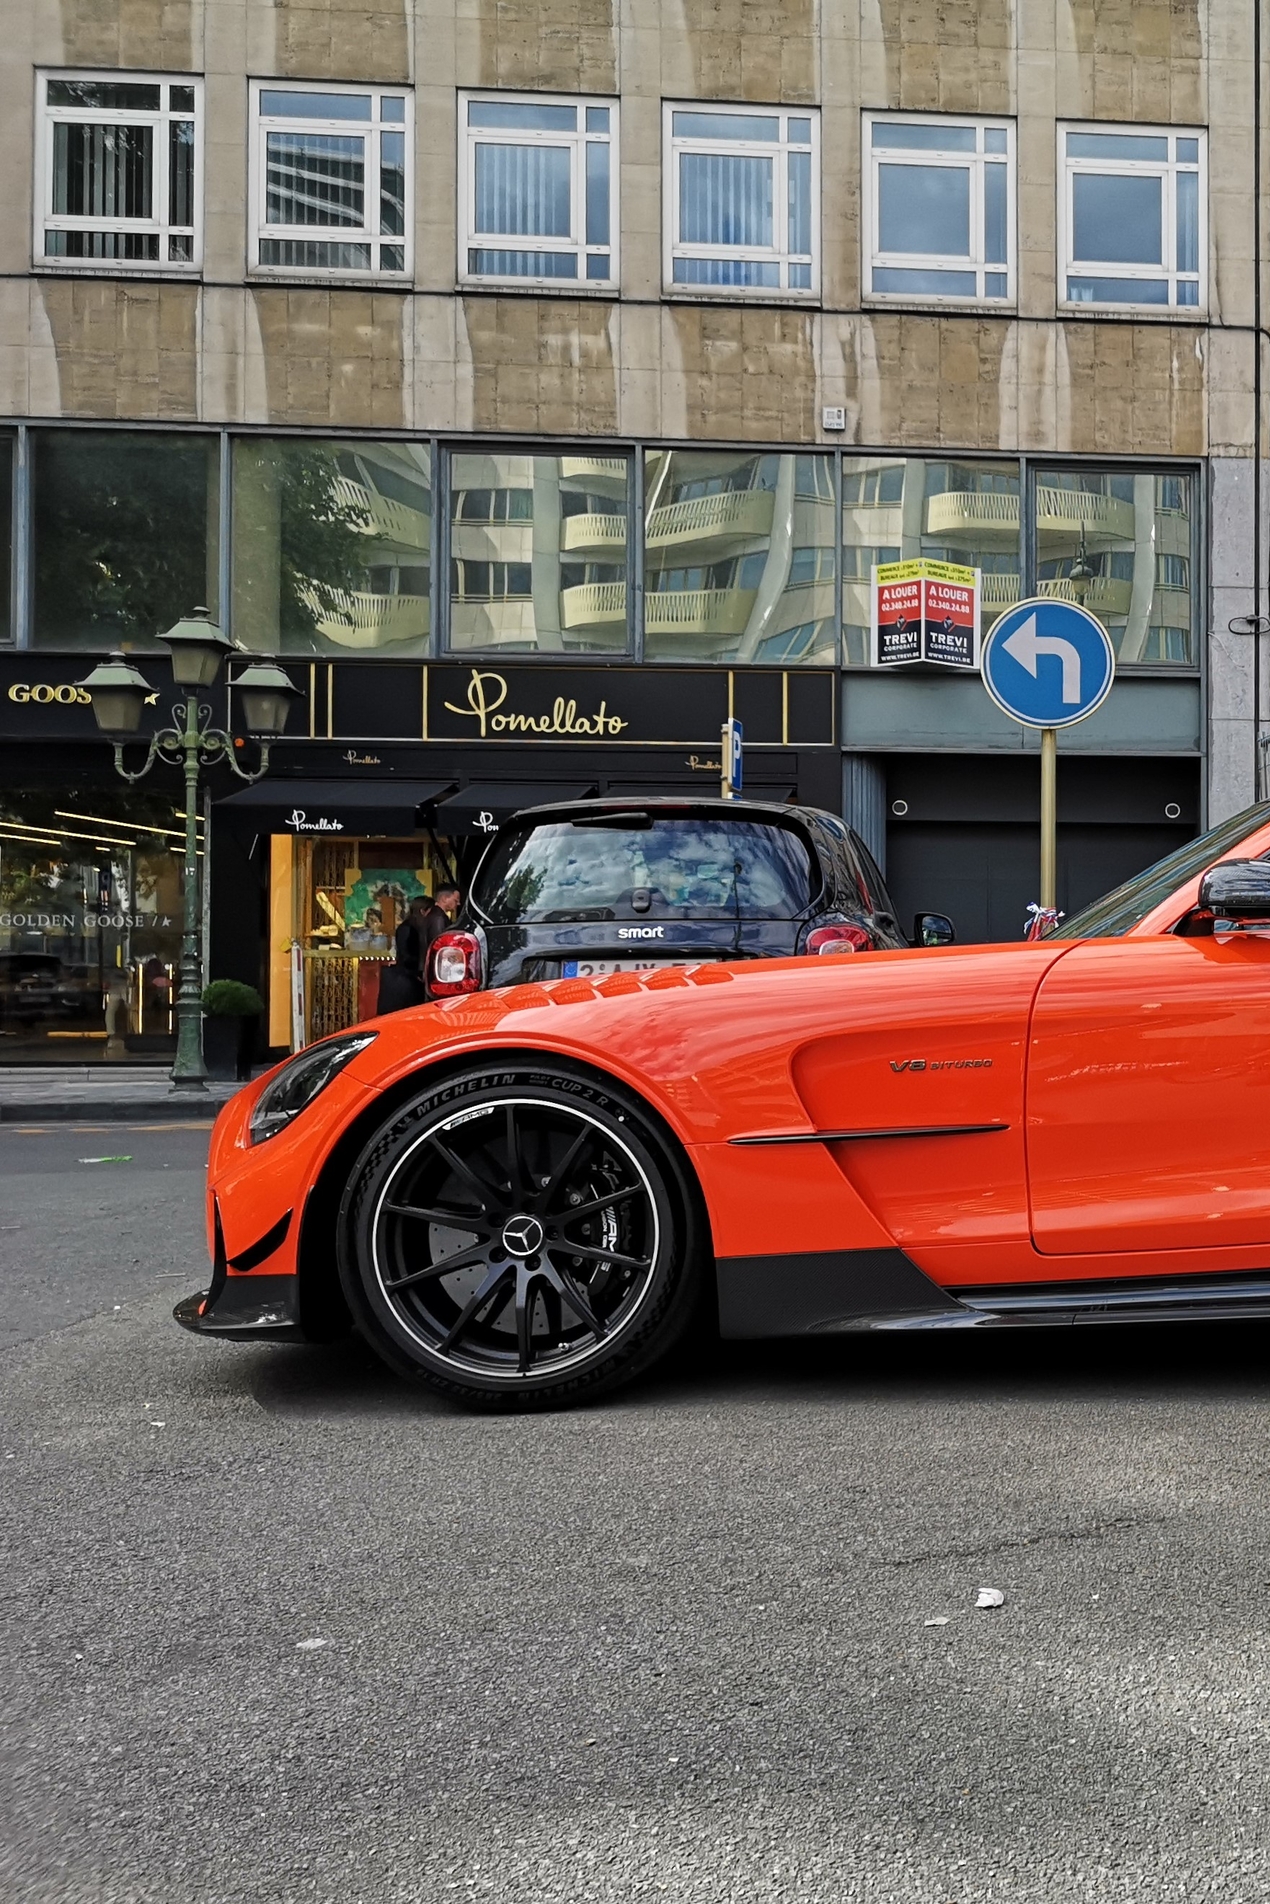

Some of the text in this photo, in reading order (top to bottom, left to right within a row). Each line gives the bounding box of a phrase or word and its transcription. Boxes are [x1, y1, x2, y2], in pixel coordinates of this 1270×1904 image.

[882, 585, 917, 600] A LOUER
[930, 585, 968, 602] A LOUER
[883, 632, 917, 646] TREVI
[930, 632, 967, 647] TREVI
[884, 642, 917, 652] CORPORATE
[930, 643, 967, 653] CORPORATE
[8, 683, 92, 704] GOOS
[444, 669, 628, 737] Pomellato
[285, 809, 344, 832] Pomellato
[0, 914, 144, 928] GOLDEN GOOSE
[618, 926, 664, 940] smart
[890, 1059, 992, 1072] V8 BITURBO
[416, 1074, 516, 1117] MICHELIN
[551, 1077, 610, 1107] CUP 2 R
